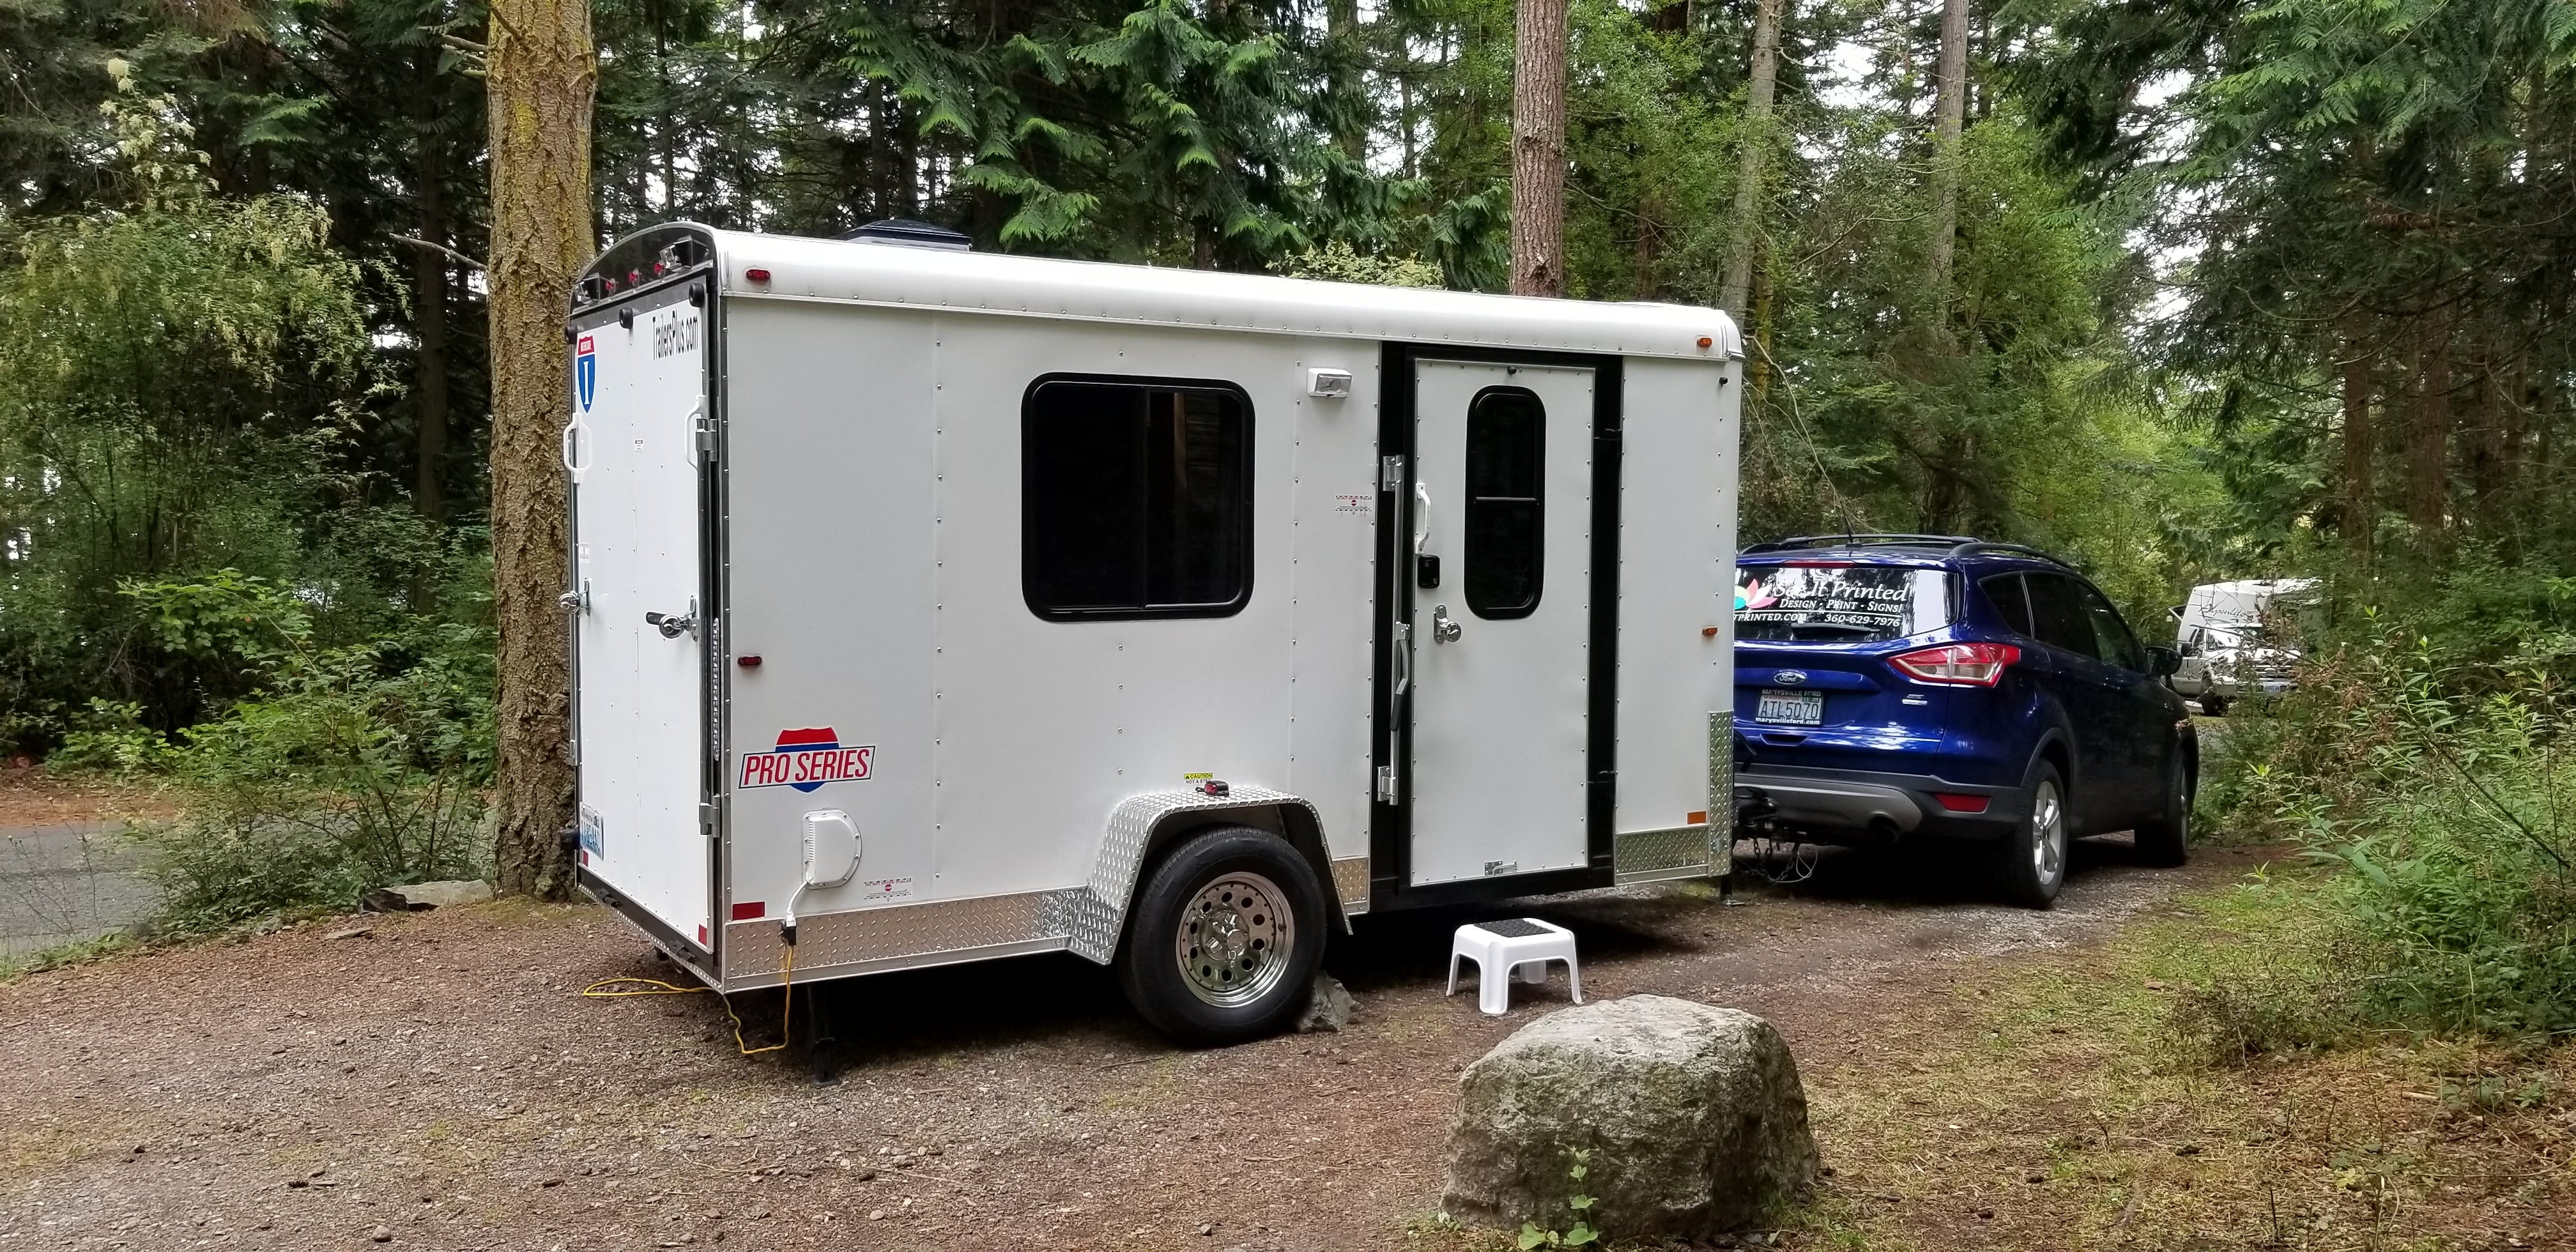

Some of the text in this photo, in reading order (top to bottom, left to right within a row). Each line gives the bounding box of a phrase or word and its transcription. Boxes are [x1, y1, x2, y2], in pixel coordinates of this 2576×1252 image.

[652, 309, 698, 360] TrailersPlus.com
[1831, 582, 1912, 602] Printed
[1779, 599, 1903, 613] DESIGN PRINT SIGNS!
[1824, 614, 1901, 627] 360-629-7976
[1760, 701, 1820, 719] ATL5070
[744, 749, 870, 785] PRO SERIES
